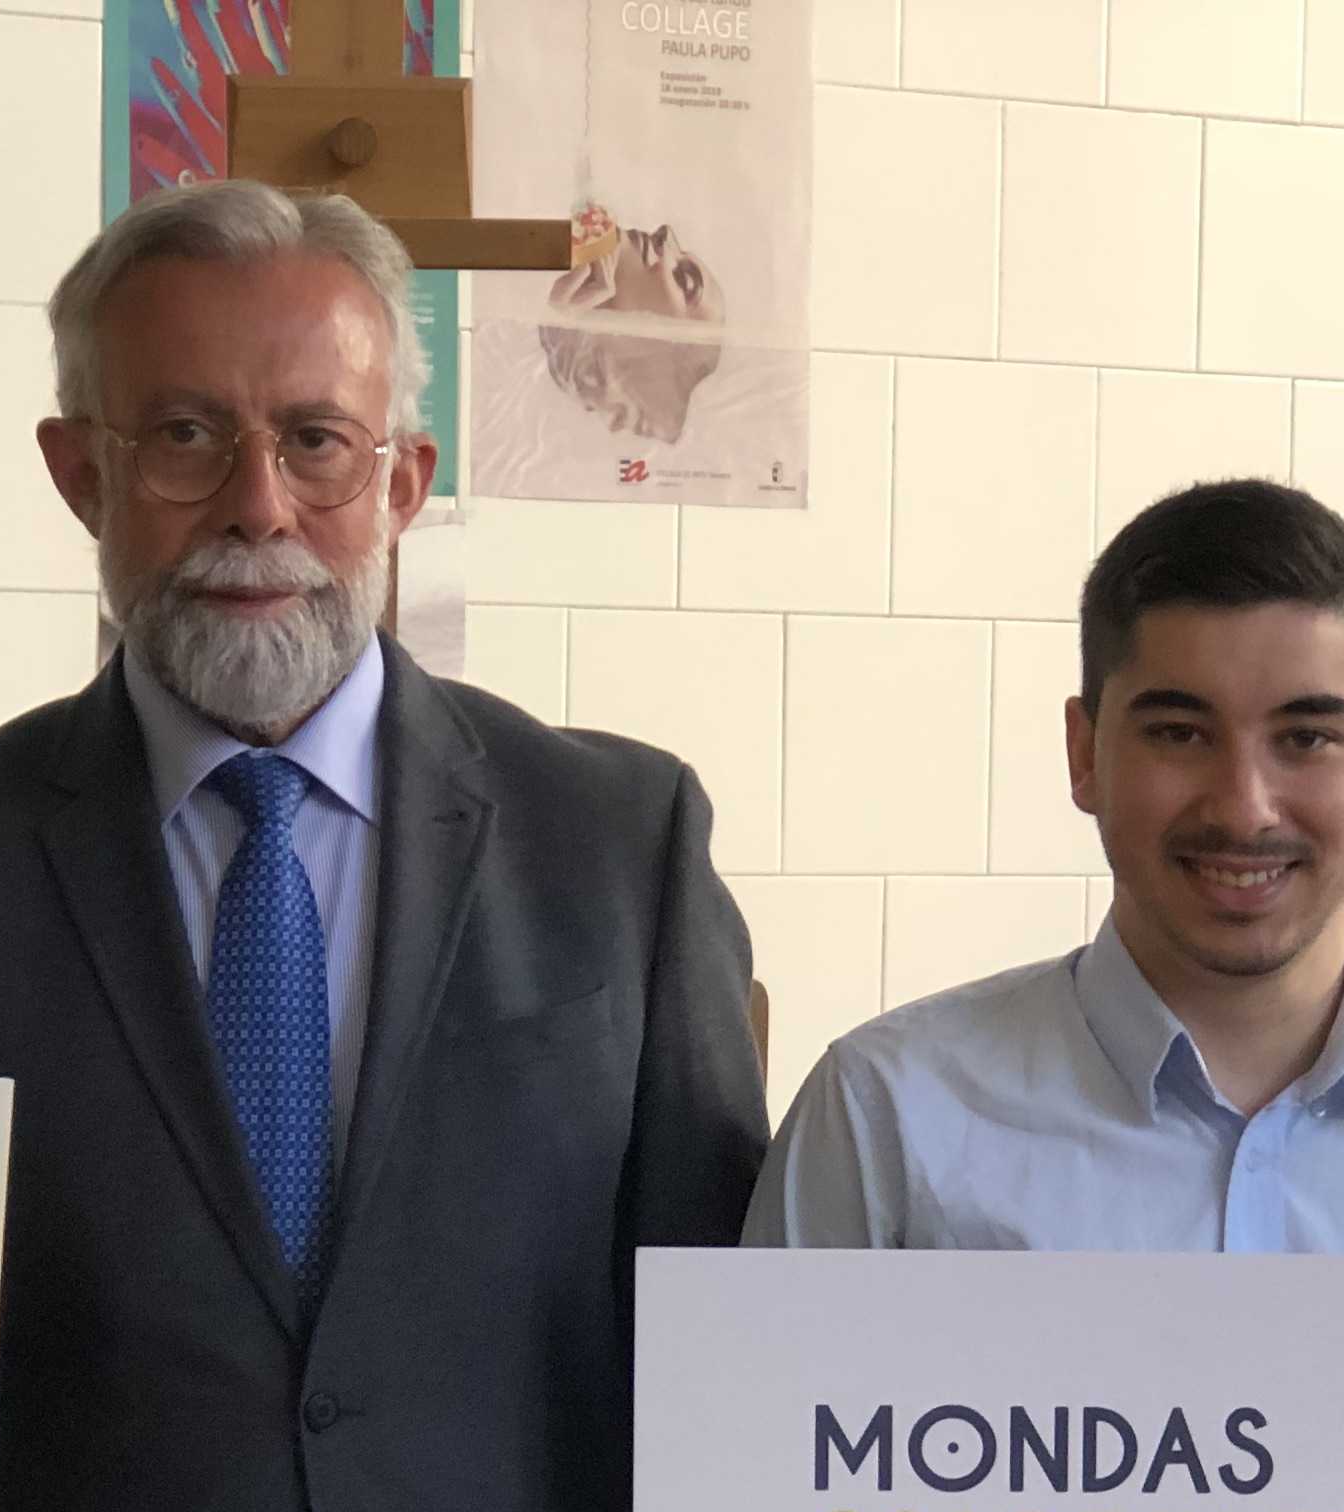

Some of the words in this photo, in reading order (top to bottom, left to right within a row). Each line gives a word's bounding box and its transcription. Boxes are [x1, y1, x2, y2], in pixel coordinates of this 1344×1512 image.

[622, 2, 749, 39] COLLAGE
[661, 39, 707, 58] PAULA
[711, 44, 751, 61] PUPO
[814, 1403, 1275, 1496] MONDAS
